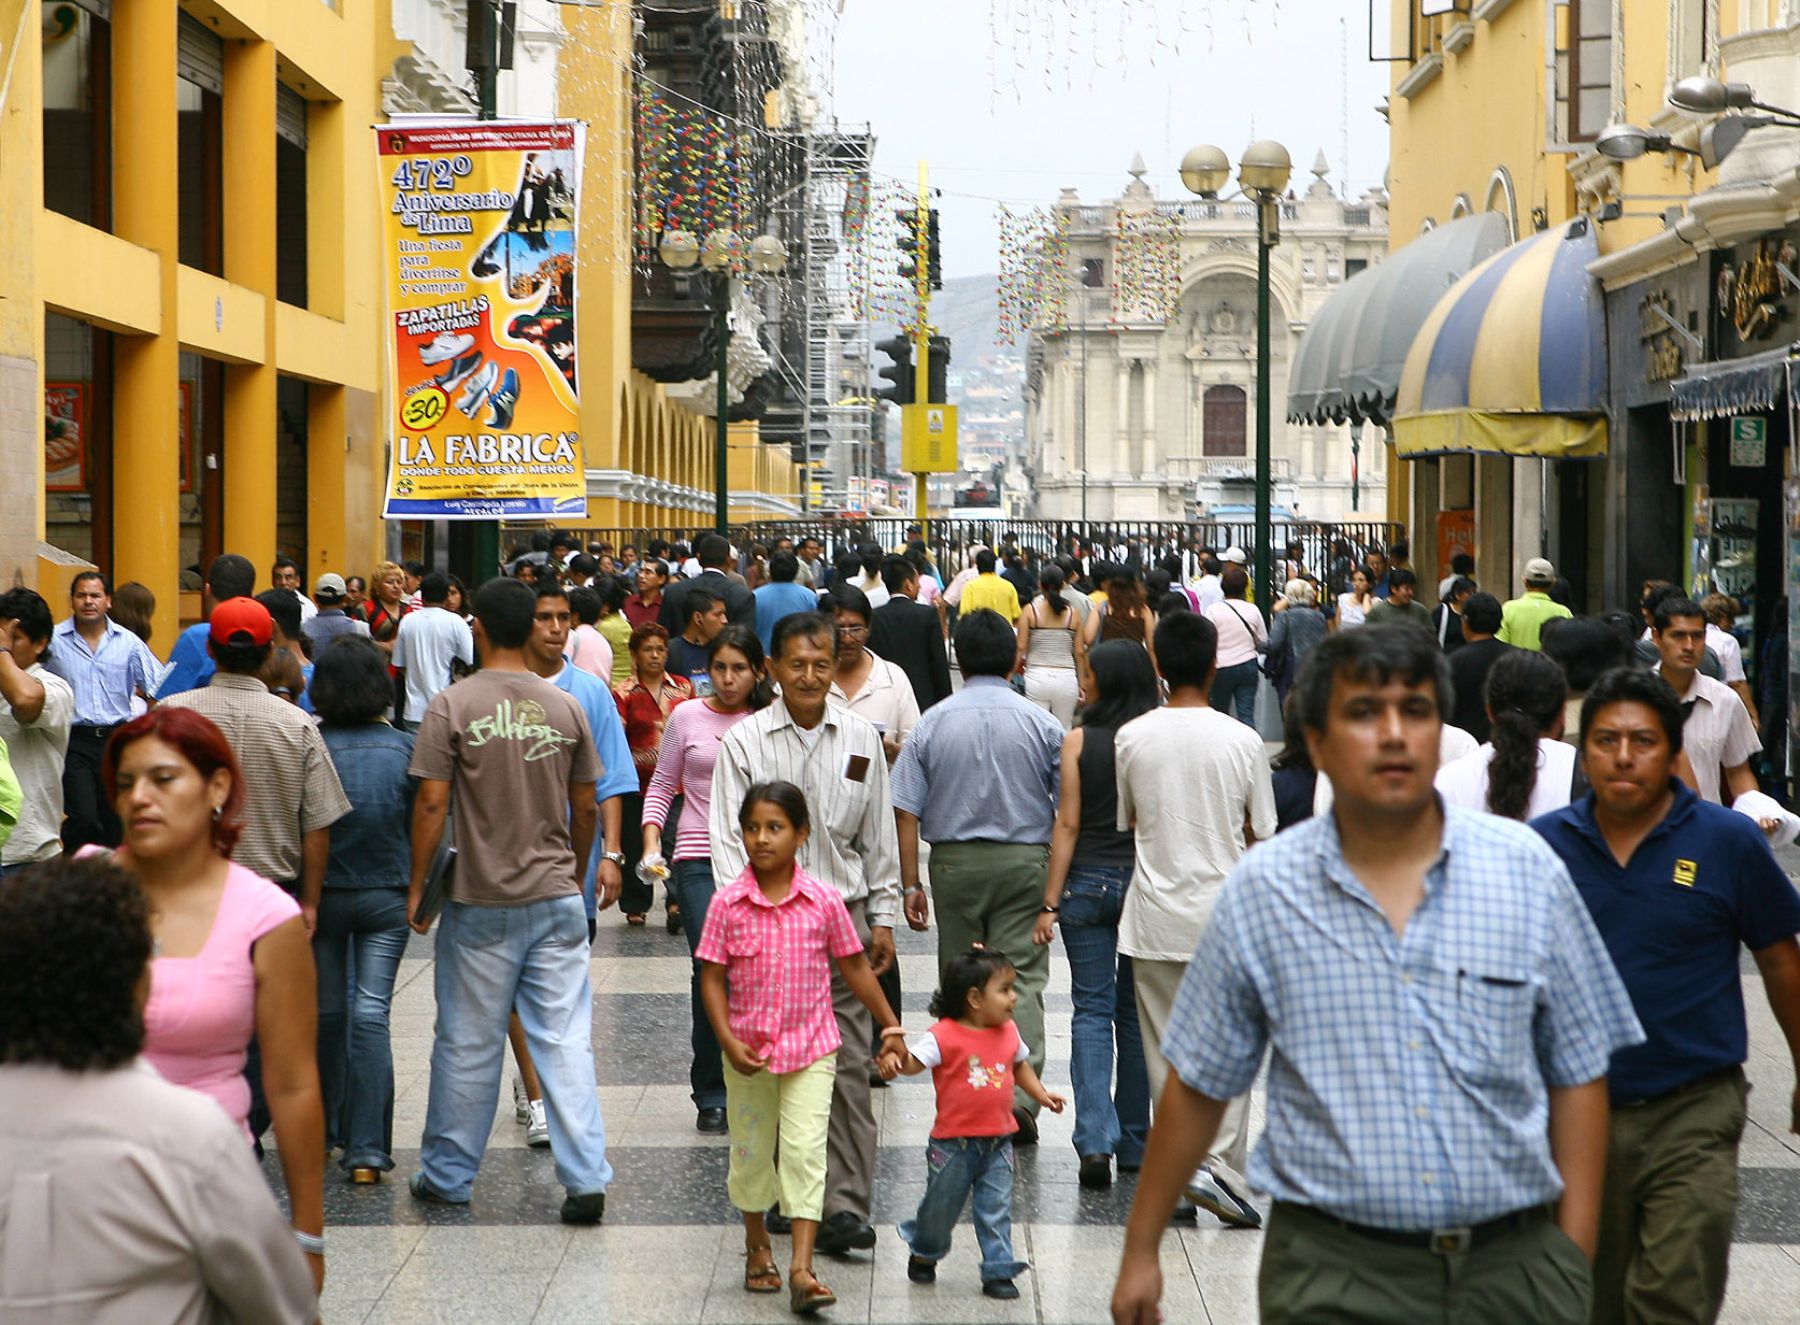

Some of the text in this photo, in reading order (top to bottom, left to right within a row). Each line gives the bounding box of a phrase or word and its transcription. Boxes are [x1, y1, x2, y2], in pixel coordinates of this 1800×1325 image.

[408, 133, 470, 143] MUNICIPALIDAD
[470, 132, 538, 141] METROPOLITANA
[538, 131, 550, 139] DE
[391, 188, 515, 213] Aniversario
[400, 211, 473, 234] de Lima
[398, 238, 463, 253] Una fiesta
[399, 255, 430, 268] para
[399, 267, 461, 280] divertirse
[399, 282, 467, 297] y comprar
[397, 294, 489, 327] ZAPATILLAS
[407, 312, 481, 336] IMPORTADAS
[1739, 420, 1758, 441] S
[398, 435, 436, 466] LA
[400, 464, 576, 476] DONDE TODO CUESTA MENOS
